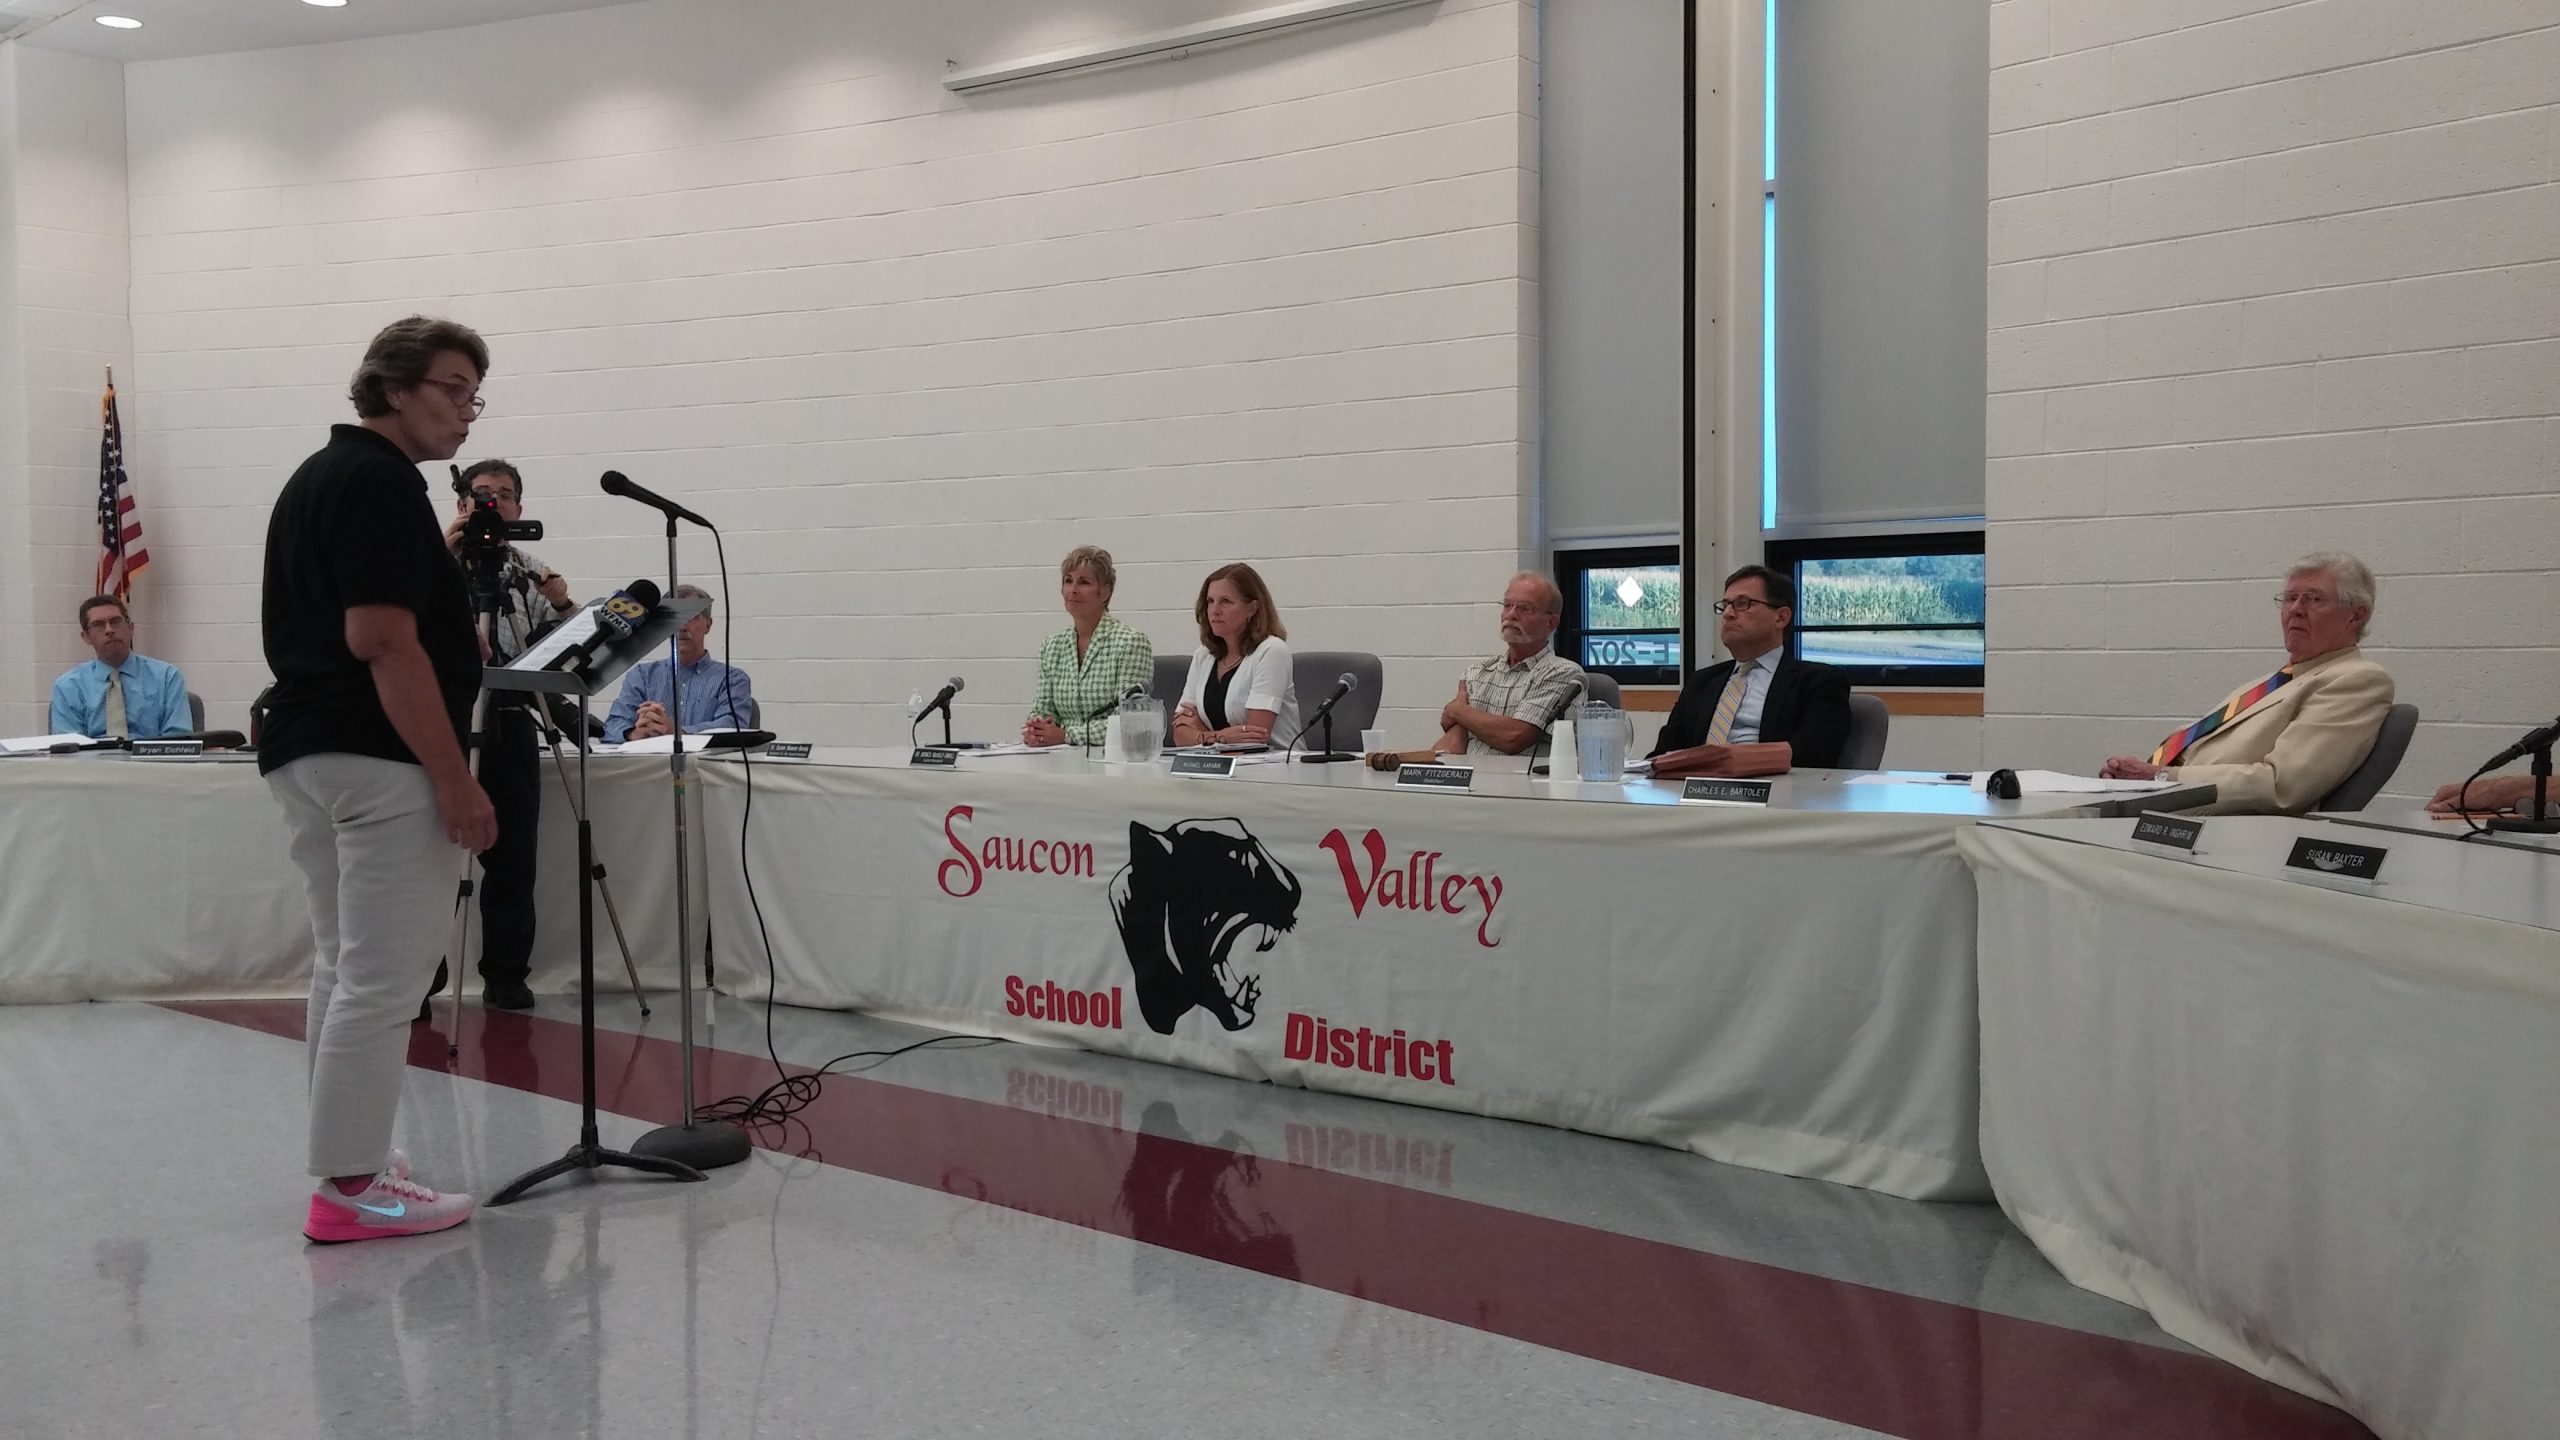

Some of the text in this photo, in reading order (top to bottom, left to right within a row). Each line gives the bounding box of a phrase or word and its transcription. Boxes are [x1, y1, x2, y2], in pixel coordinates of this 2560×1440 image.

[607, 597, 645, 619] 69
[600, 606, 629, 632] WFMZ
[139, 746, 161, 754] Bryan
[1402, 768, 1470, 779] MARK FITZGERALD
[1688, 785, 1719, 795] CHARLES
[1729, 787, 1767, 797] BARTOLET
[2306, 849, 2365, 867] SUSAN BAXTER
[938, 805, 1503, 948] Saucon Valley
[1005, 975, 1455, 1085] School District
